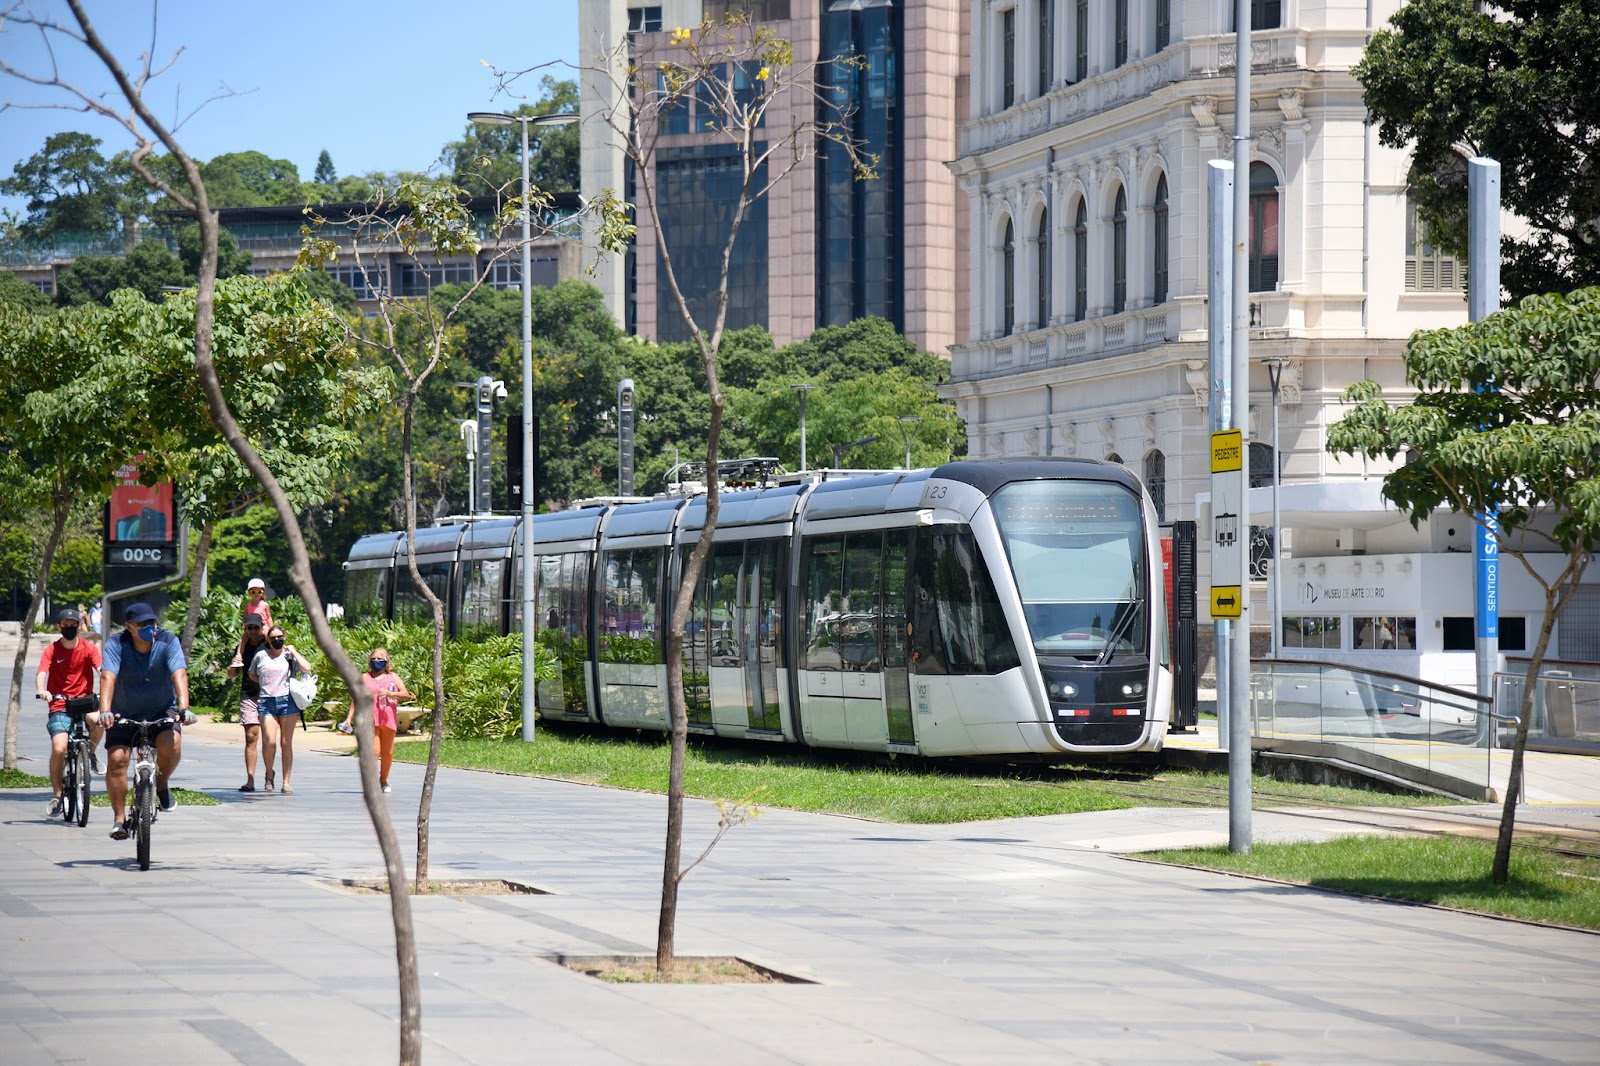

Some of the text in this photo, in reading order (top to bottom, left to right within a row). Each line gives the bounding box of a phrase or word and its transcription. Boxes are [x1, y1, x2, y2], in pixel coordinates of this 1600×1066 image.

[1215, 447, 1239, 460] PEDESTRE
[1324, 587, 1385, 599] MUSEU DE ARTE DO RIO
[1487, 565, 1497, 611] SENTIDO
